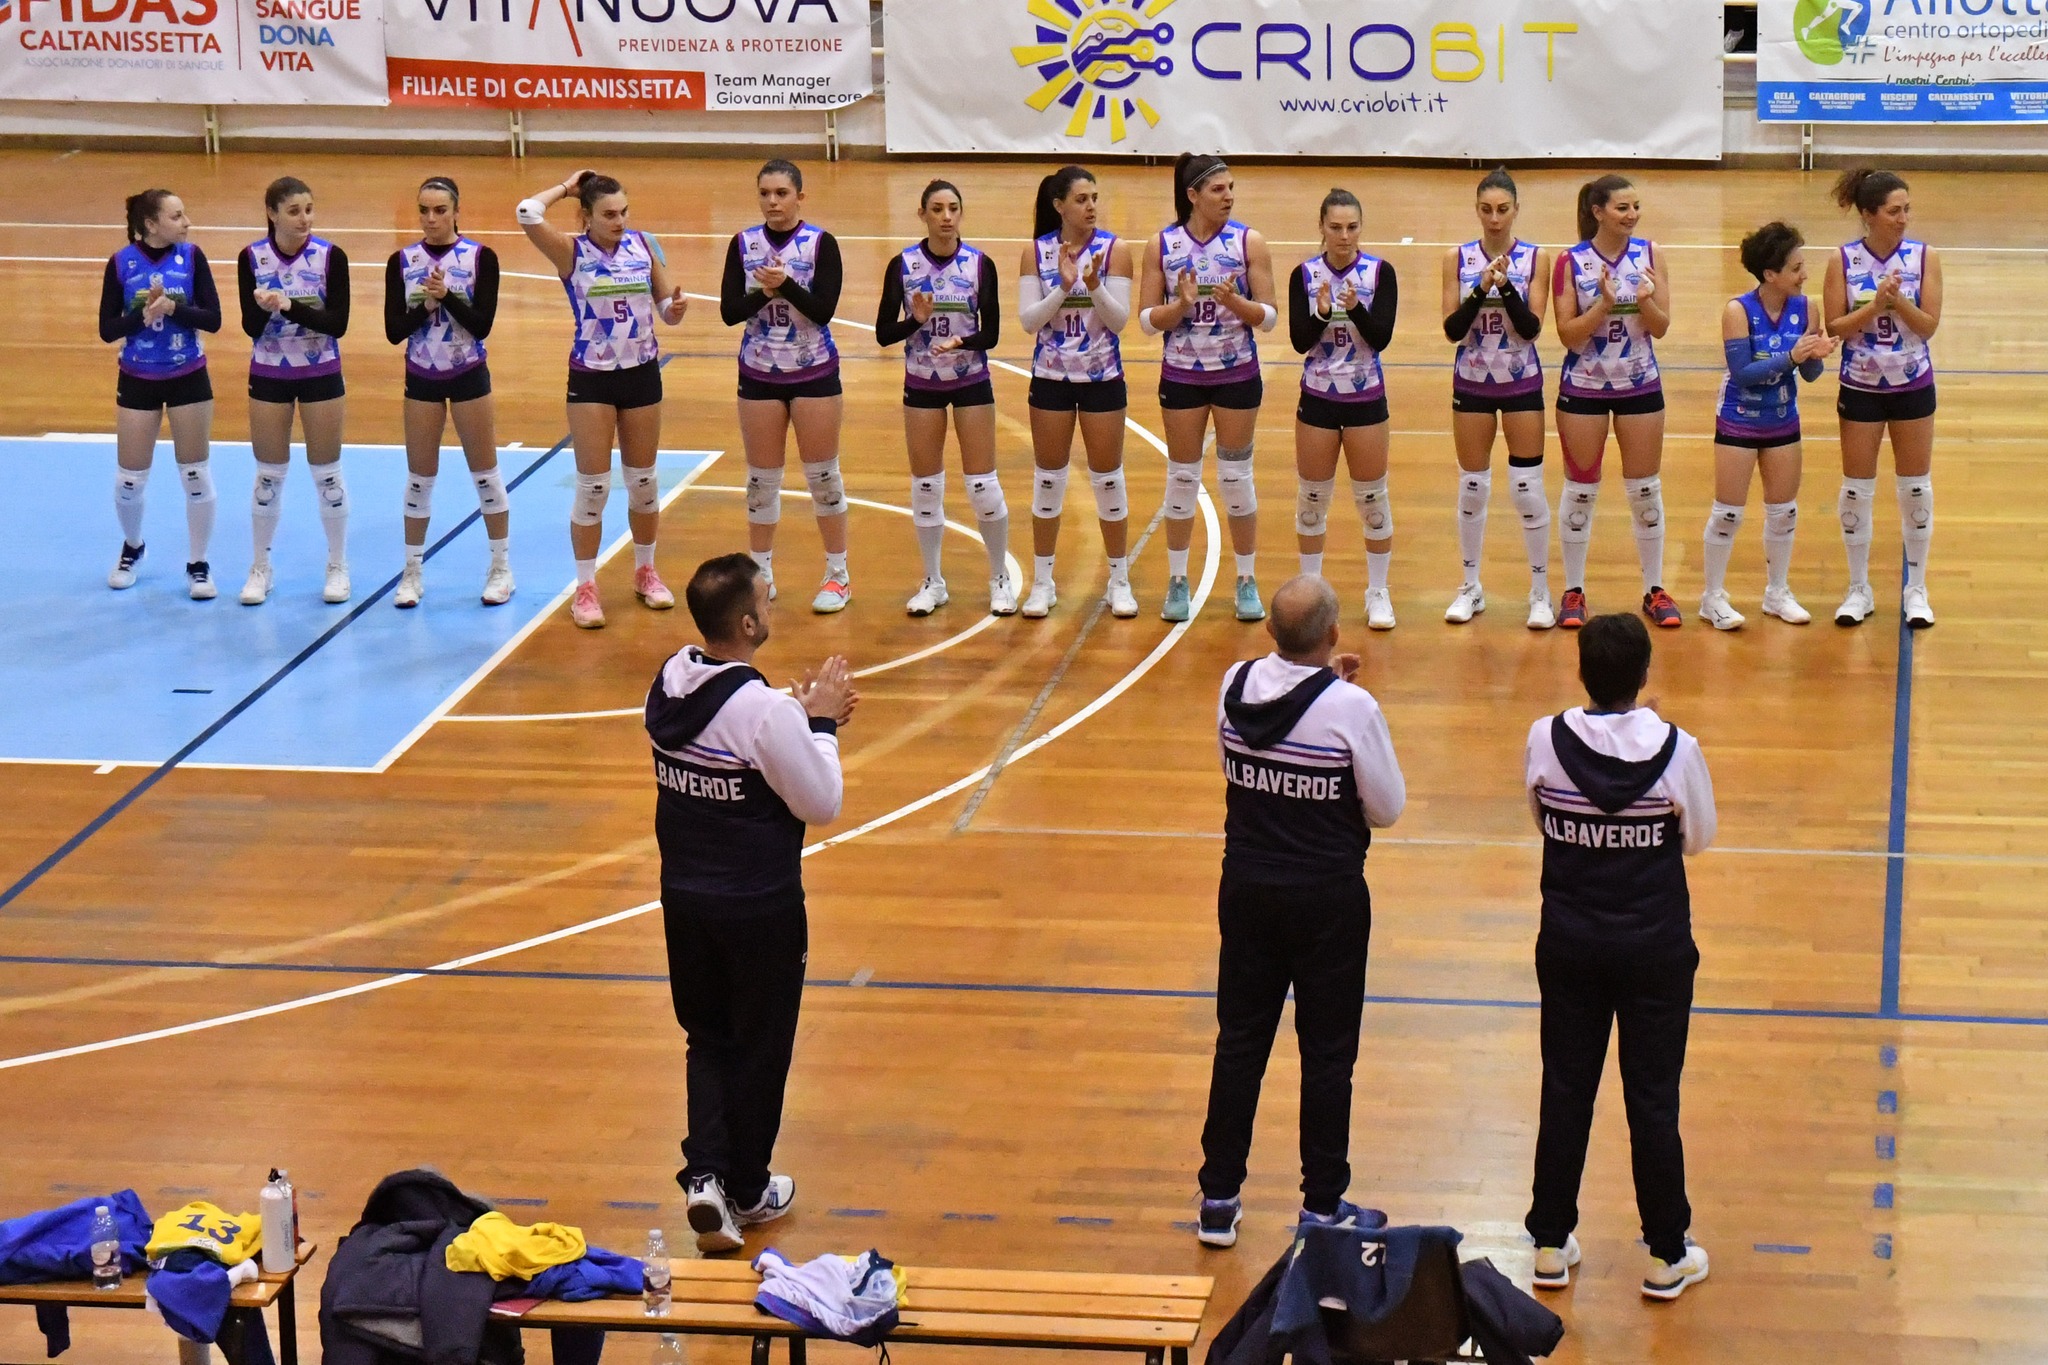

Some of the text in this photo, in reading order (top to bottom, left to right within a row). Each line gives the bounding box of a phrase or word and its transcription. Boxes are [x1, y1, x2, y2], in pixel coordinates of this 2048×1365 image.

[256, 0, 361, 20] SANGUE
[20, 29, 222, 54] CALTANISSETTA
[259, 24, 335, 47] DONA
[1884, 19, 2048, 42] centro ortopedi
[618, 38, 843, 52] PREVIDENZA & PROTEZIONE
[1191, 22, 1578, 82] CRIOBIT
[24, 56, 225, 71] ASSOCIAZIONE DONATORI DI SANGUE
[260, 51, 314, 72] VITA
[1884, 46, 1956, 69] L'impegno
[1961, 52, 1983, 67] per
[402, 75, 692, 99] FILIALE DI CALTANISSETTA
[715, 74, 831, 90] Team Manager
[1896, 74, 1930, 86] nostri
[1936, 74, 1975, 87] Centri:
[716, 91, 862, 105] Giovanni Minacore
[1279, 91, 1449, 114] www.criobit.it
[1198, 275, 1228, 285] TRAIN
[935, 294, 966, 302] TRAINA
[613, 300, 628, 324] 5
[767, 303, 790, 328] 15
[1192, 301, 1217, 324] 18
[930, 316, 951, 338] 13
[1065, 314, 1082, 338] 11
[1480, 313, 1503, 335] 12
[1608, 320, 1623, 344] 2
[1877, 316, 1892, 339] 9
[1333, 326, 1347, 348] 6
[656, 760, 746, 802] BAVERDE
[1225, 756, 1341, 801] ALBAVERDE
[1544, 813, 1666, 849] ALBAVERDE
[176, 1213, 242, 1245] 13
